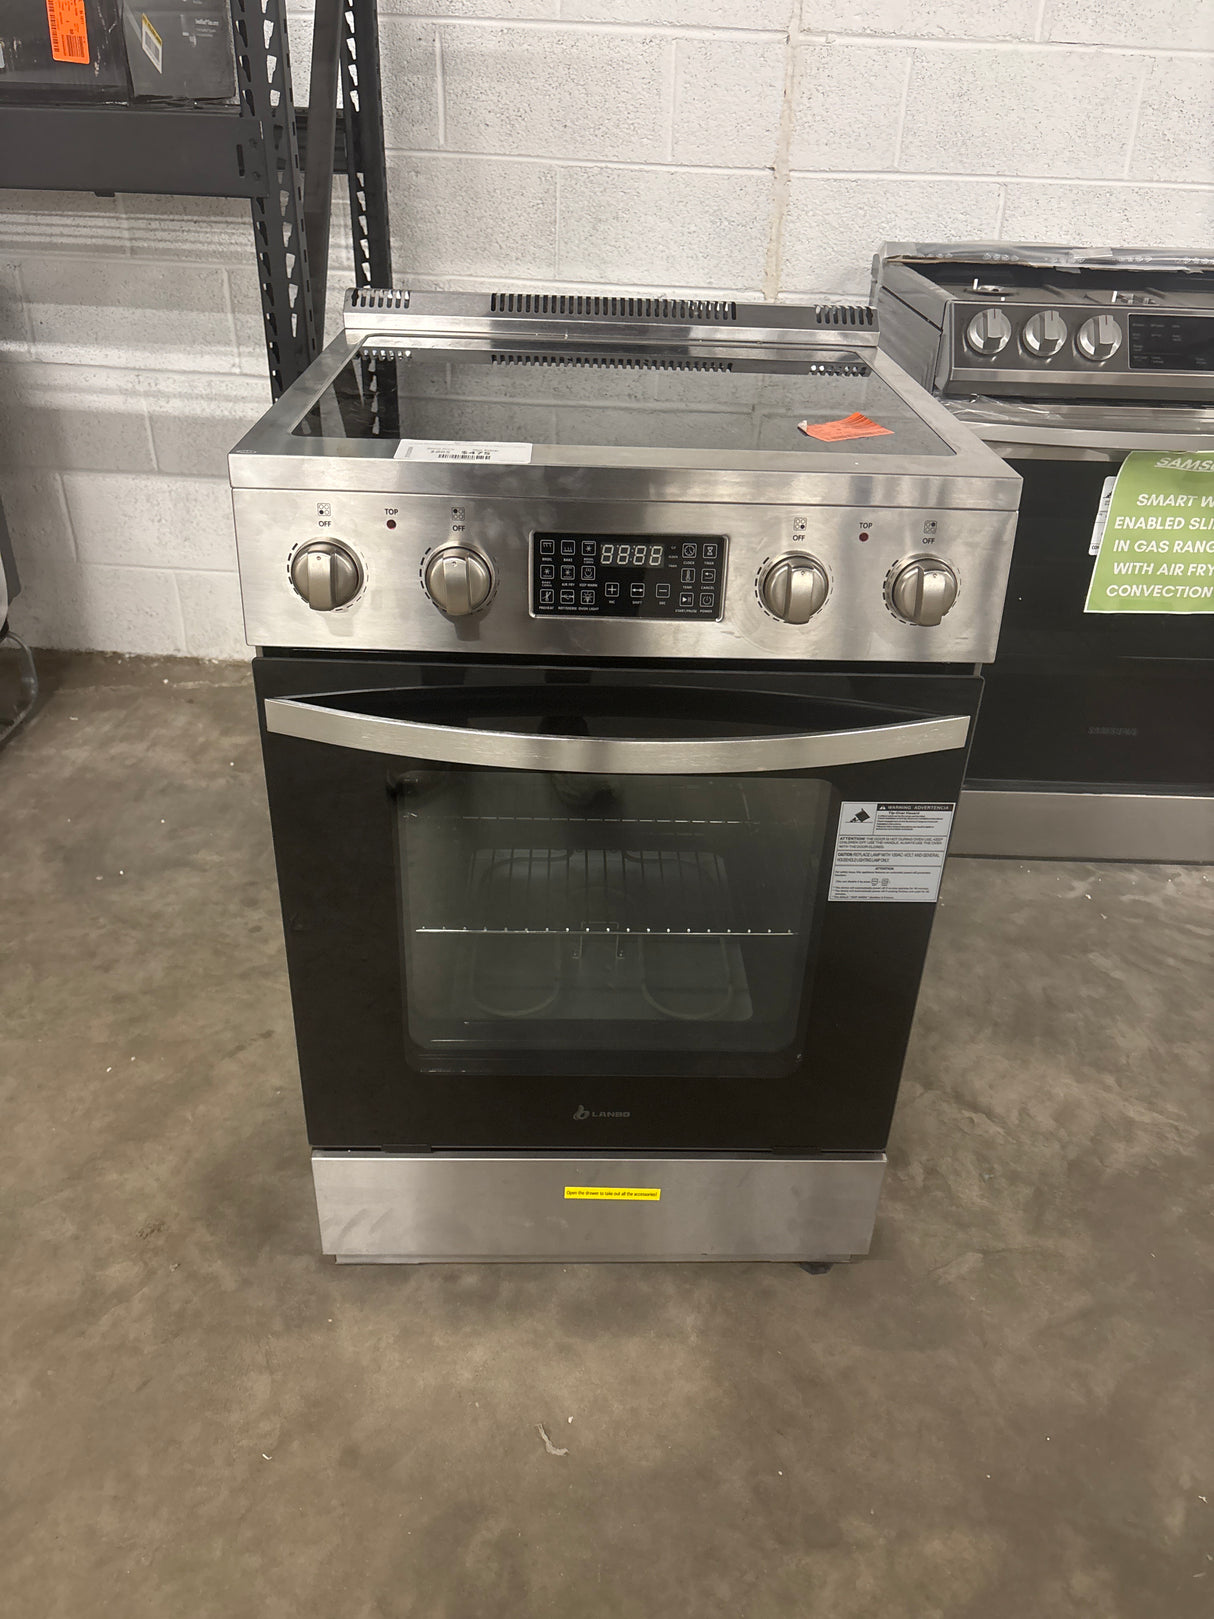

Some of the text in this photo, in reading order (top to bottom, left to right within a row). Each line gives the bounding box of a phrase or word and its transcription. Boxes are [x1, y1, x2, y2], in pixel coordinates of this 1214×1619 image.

[1156, 457, 1214, 470] SAMS
[1136, 493, 1198, 507] SMART
[1114, 516, 1214, 530] ENABLED SLI
[792, 534, 806, 542] OFF
[922, 537, 935, 545] OFF
[1113, 539, 1130, 552] IN
[1134, 540, 1169, 553] GAS
[1113, 562, 1154, 575] WITH
[1156, 563, 1185, 576] AIR
[1106, 584, 1213, 598] CONVECTION
